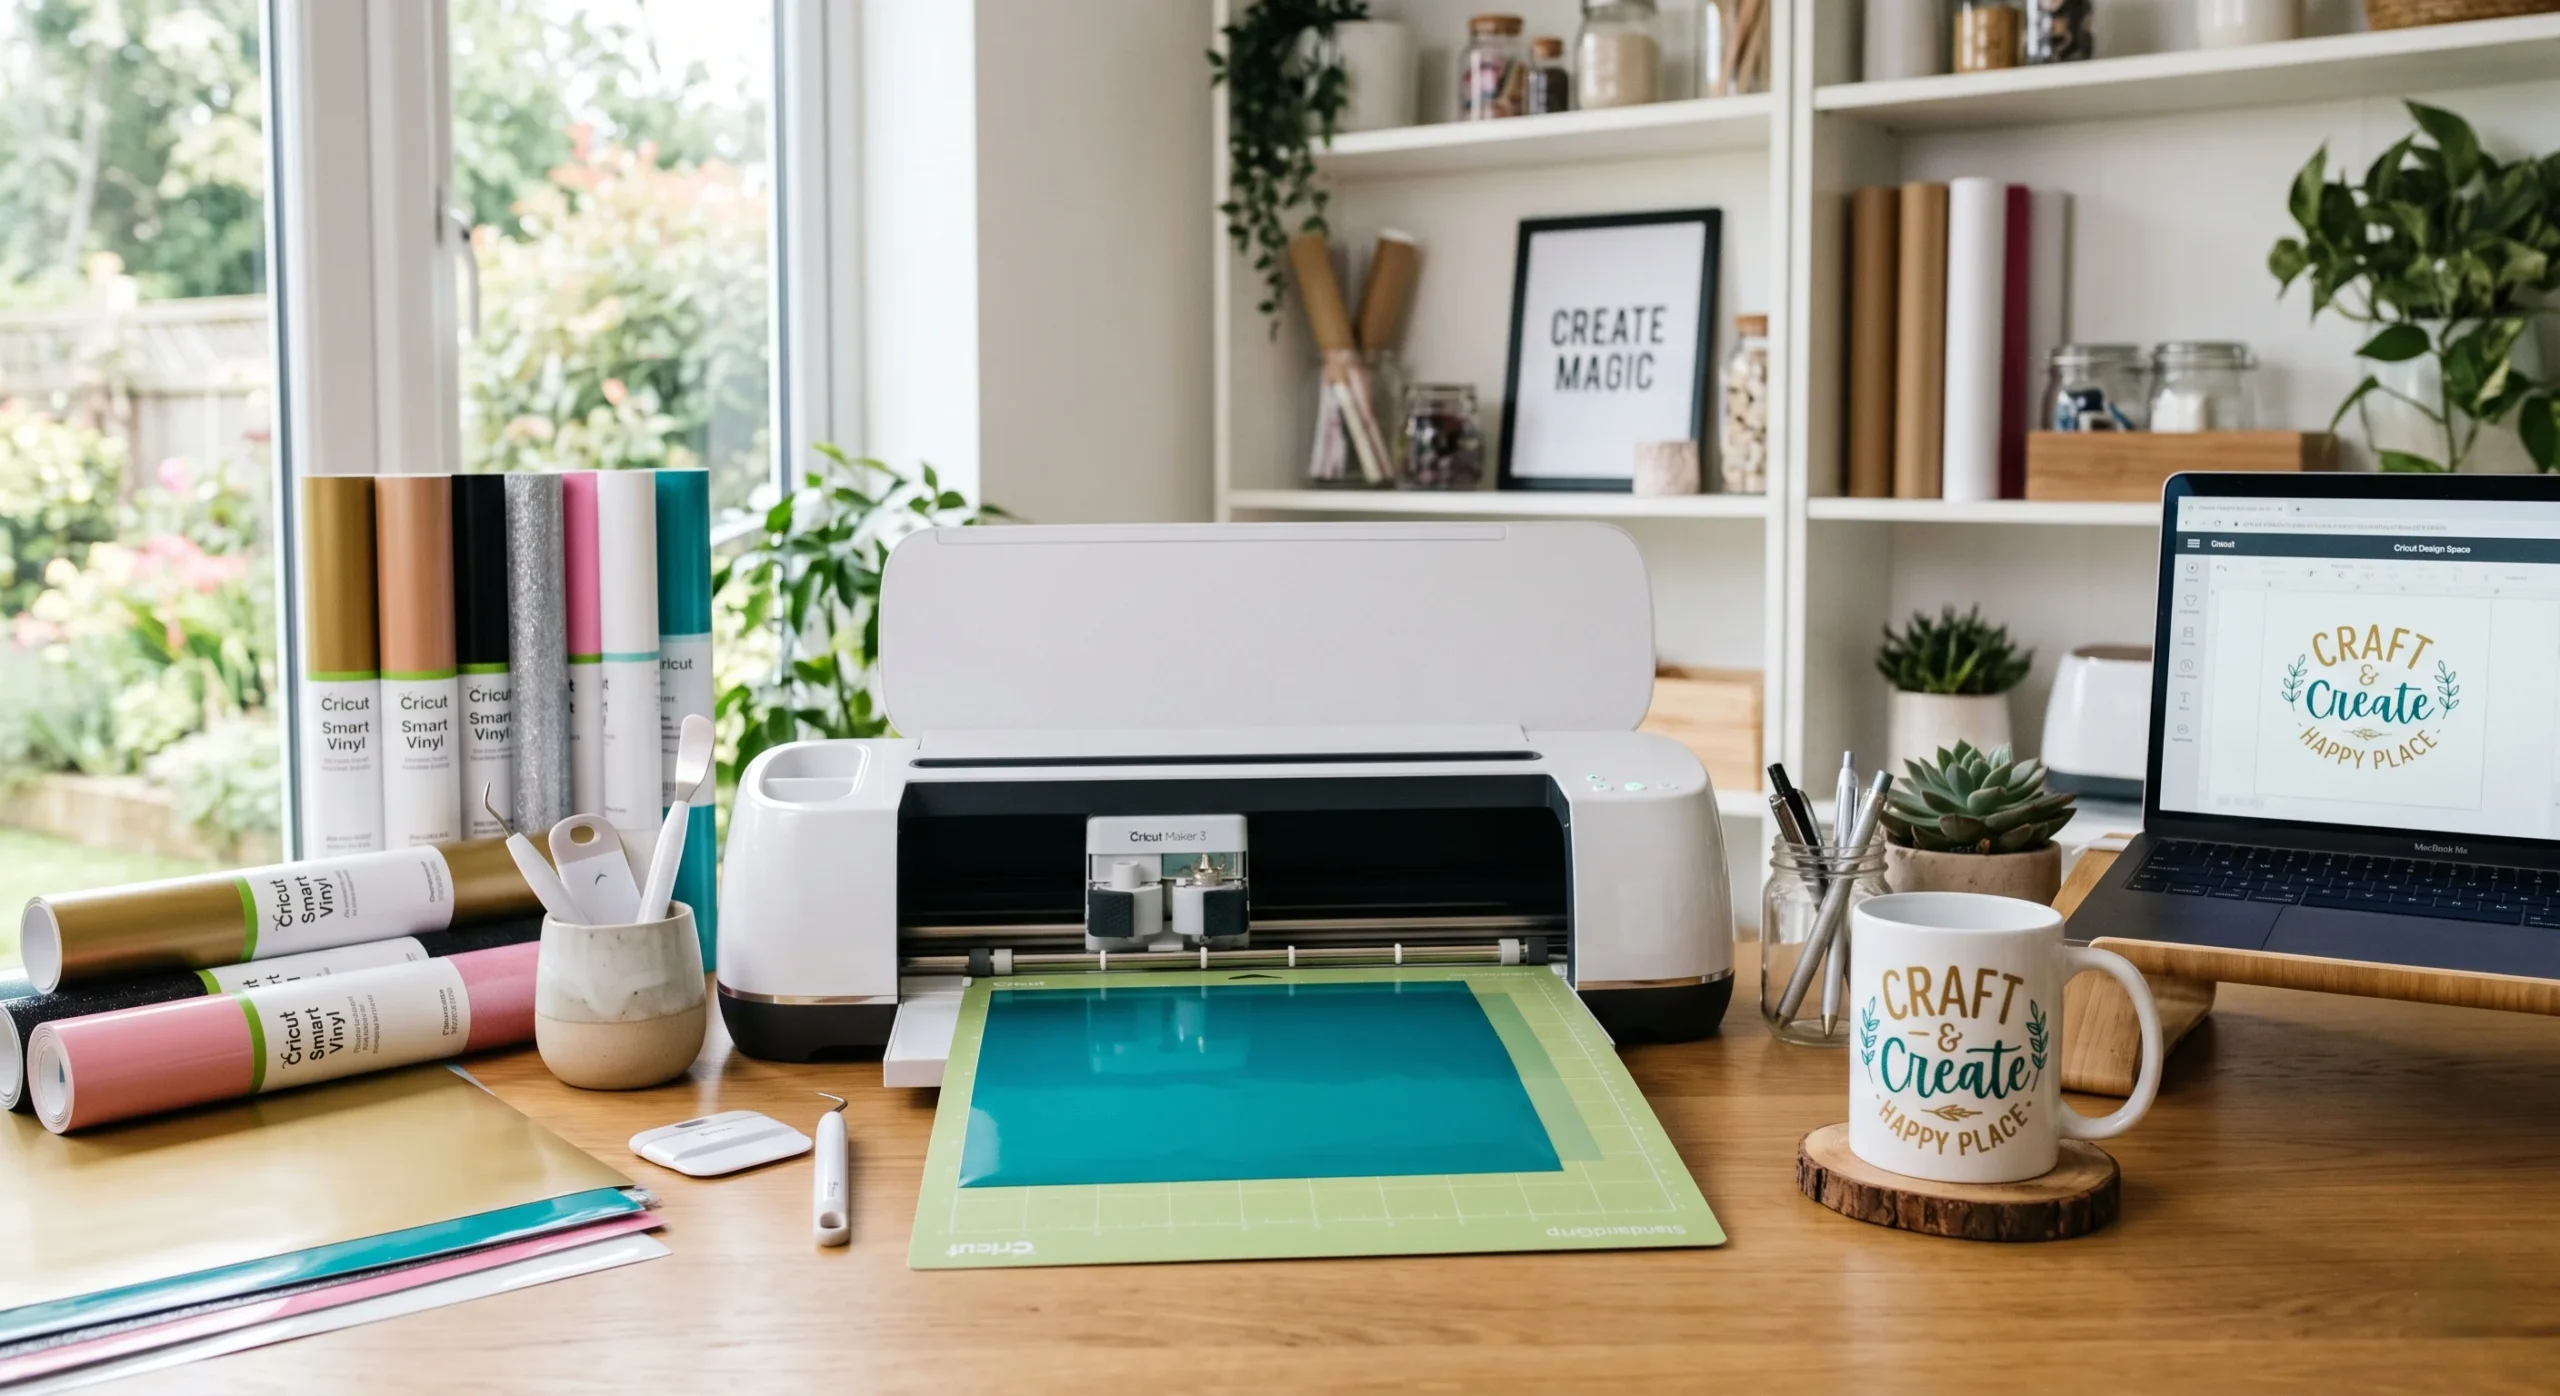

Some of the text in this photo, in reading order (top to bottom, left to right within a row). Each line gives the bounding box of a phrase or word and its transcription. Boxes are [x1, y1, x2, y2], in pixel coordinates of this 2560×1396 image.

[1551, 305, 1667, 346] CREATE
[1555, 351, 1655, 391] MAGIC
[660, 658, 693, 670] ricut
[2312, 624, 2434, 670] CRAFT
[2358, 663, 2379, 686] &
[321, 695, 370, 711] Cricut
[400, 693, 448, 710] Cricut
[2306, 679, 2435, 724] Create
[322, 720, 370, 735] Smart
[327, 736, 366, 753] Vinyl
[402, 719, 448, 733] Smart
[406, 734, 444, 751] Vinyl
[2300, 726, 2438, 770] HAPPY PLACE
[1129, 830, 1207, 842] Cricut Maker 3
[270, 879, 293, 930] Cricut
[294, 876, 316, 923] Smart
[313, 877, 334, 918] Vinyl
[1882, 965, 2024, 1025] CRAFT
[280, 1011, 302, 1068] Cricut
[326, 1011, 345, 1054] Vinyl
[1937, 1022, 1963, 1053] &
[1881, 1036, 2031, 1100] Create
[1878, 1099, 2029, 1156] HAPPY PLACE
[945, 1240, 1034, 1257] Cricut
